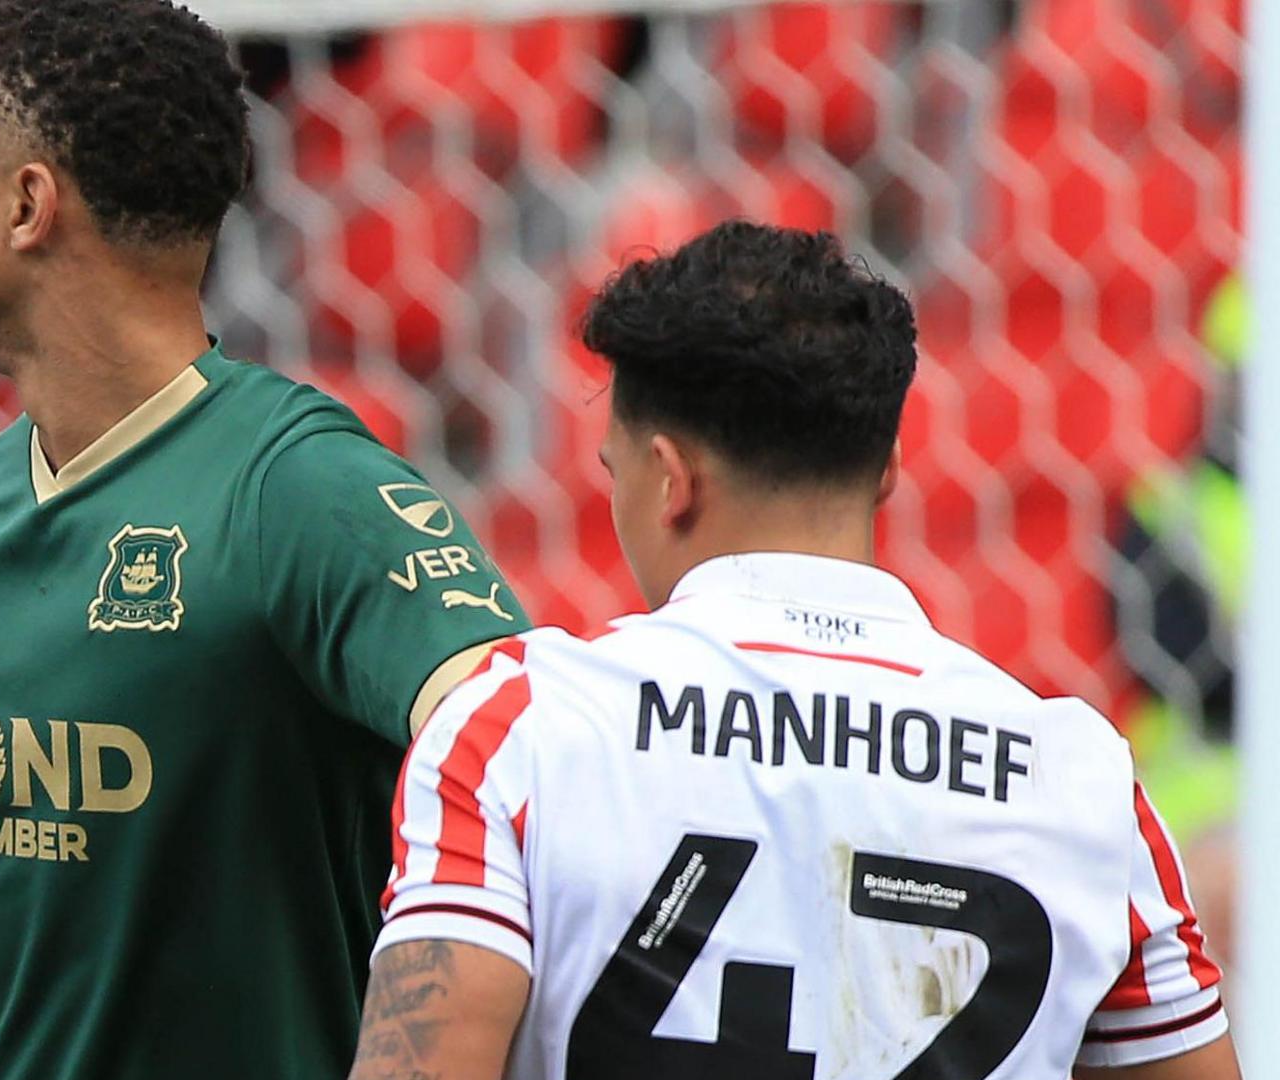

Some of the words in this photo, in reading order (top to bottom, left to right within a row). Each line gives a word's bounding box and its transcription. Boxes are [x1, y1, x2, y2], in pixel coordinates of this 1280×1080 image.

[388, 545, 488, 591] VER
[784, 608, 869, 640] STOKE
[635, 680, 1033, 803] MANHOEF
